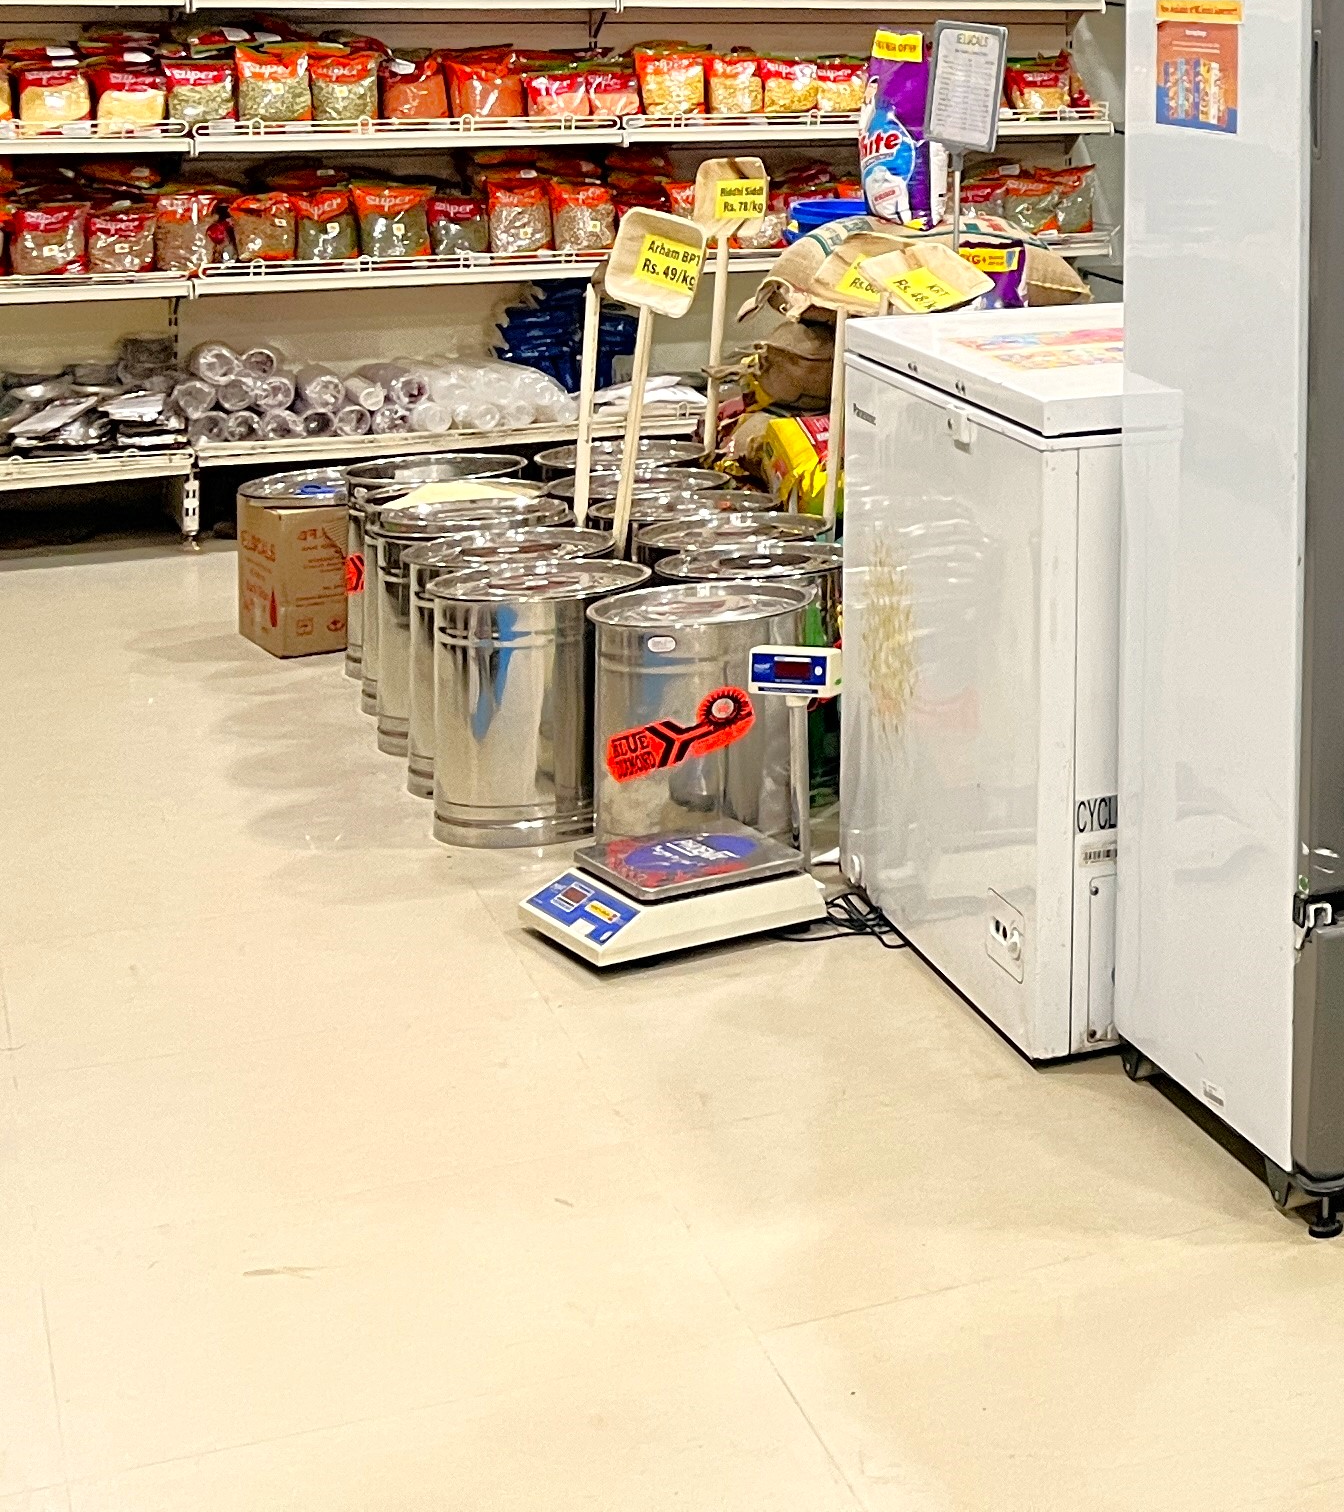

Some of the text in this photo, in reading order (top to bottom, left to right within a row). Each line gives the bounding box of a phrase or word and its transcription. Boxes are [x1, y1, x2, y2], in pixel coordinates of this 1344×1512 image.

[366, 193, 415, 211] super
[723, 200, 764, 214] Rs. 78/kg
[642, 258, 661, 276] Rs.
[1076, 797, 1118, 834] CYCL
